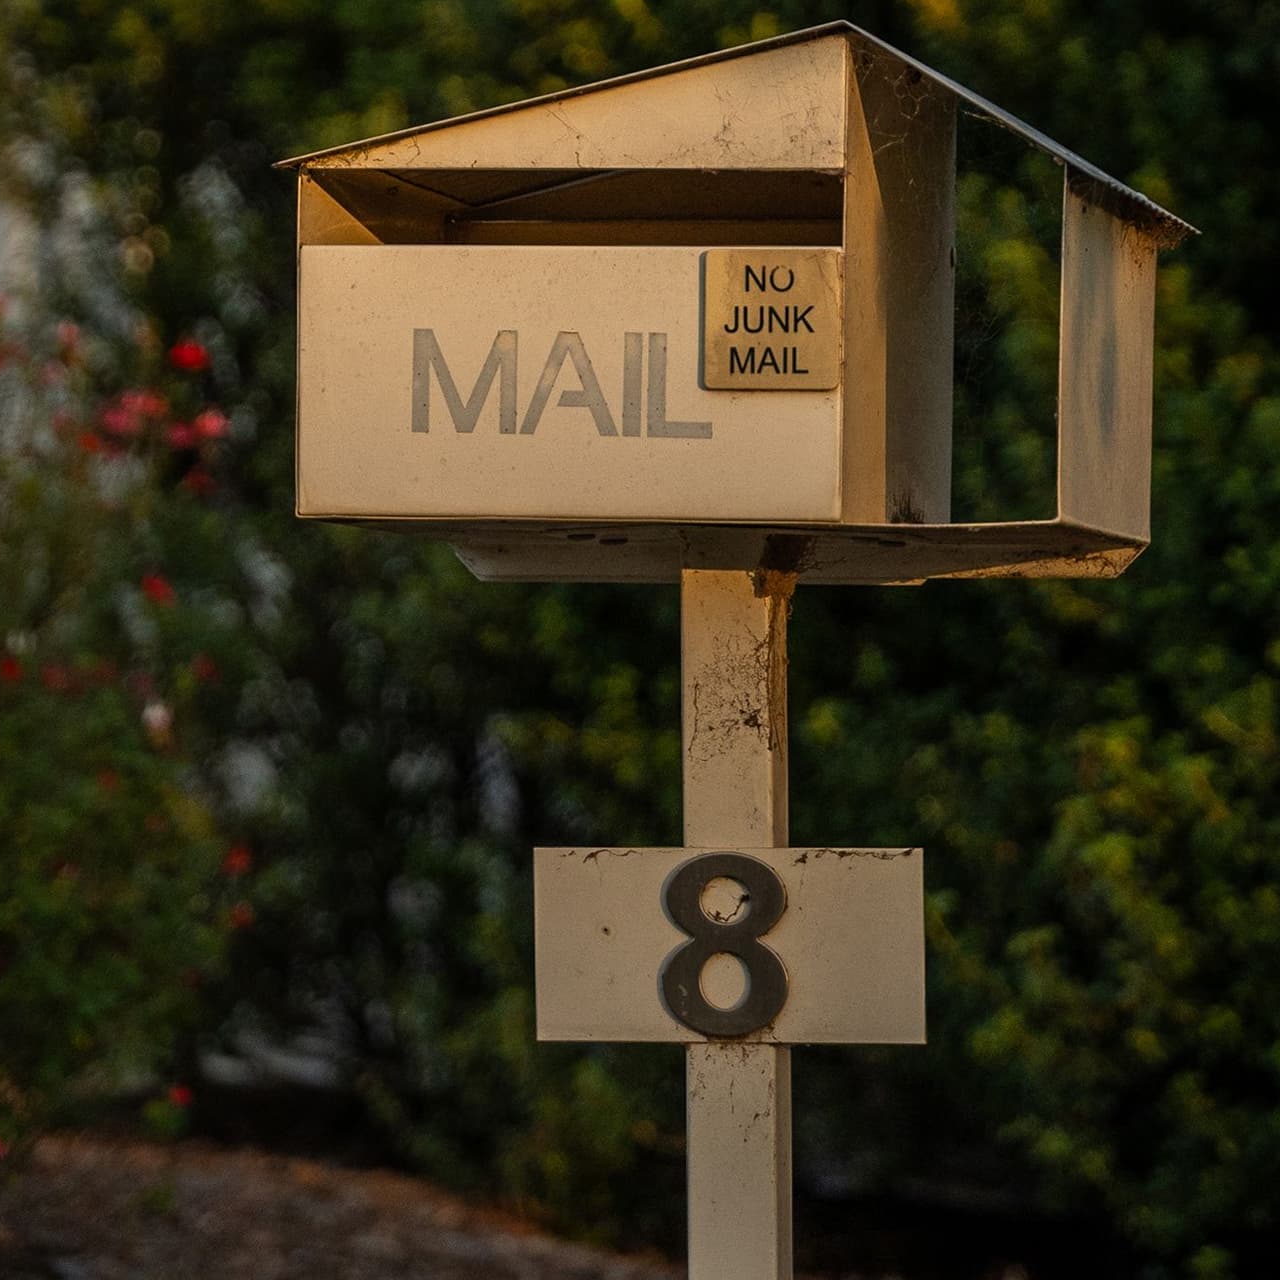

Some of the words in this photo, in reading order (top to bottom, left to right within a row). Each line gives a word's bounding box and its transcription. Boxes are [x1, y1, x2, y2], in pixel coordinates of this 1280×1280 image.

[745, 265, 794, 292] NO
[724, 306, 815, 333] JUNK
[730, 347, 809, 374] MAIL
[411, 328, 713, 439] MAIL
[659, 851, 789, 1039] 8
